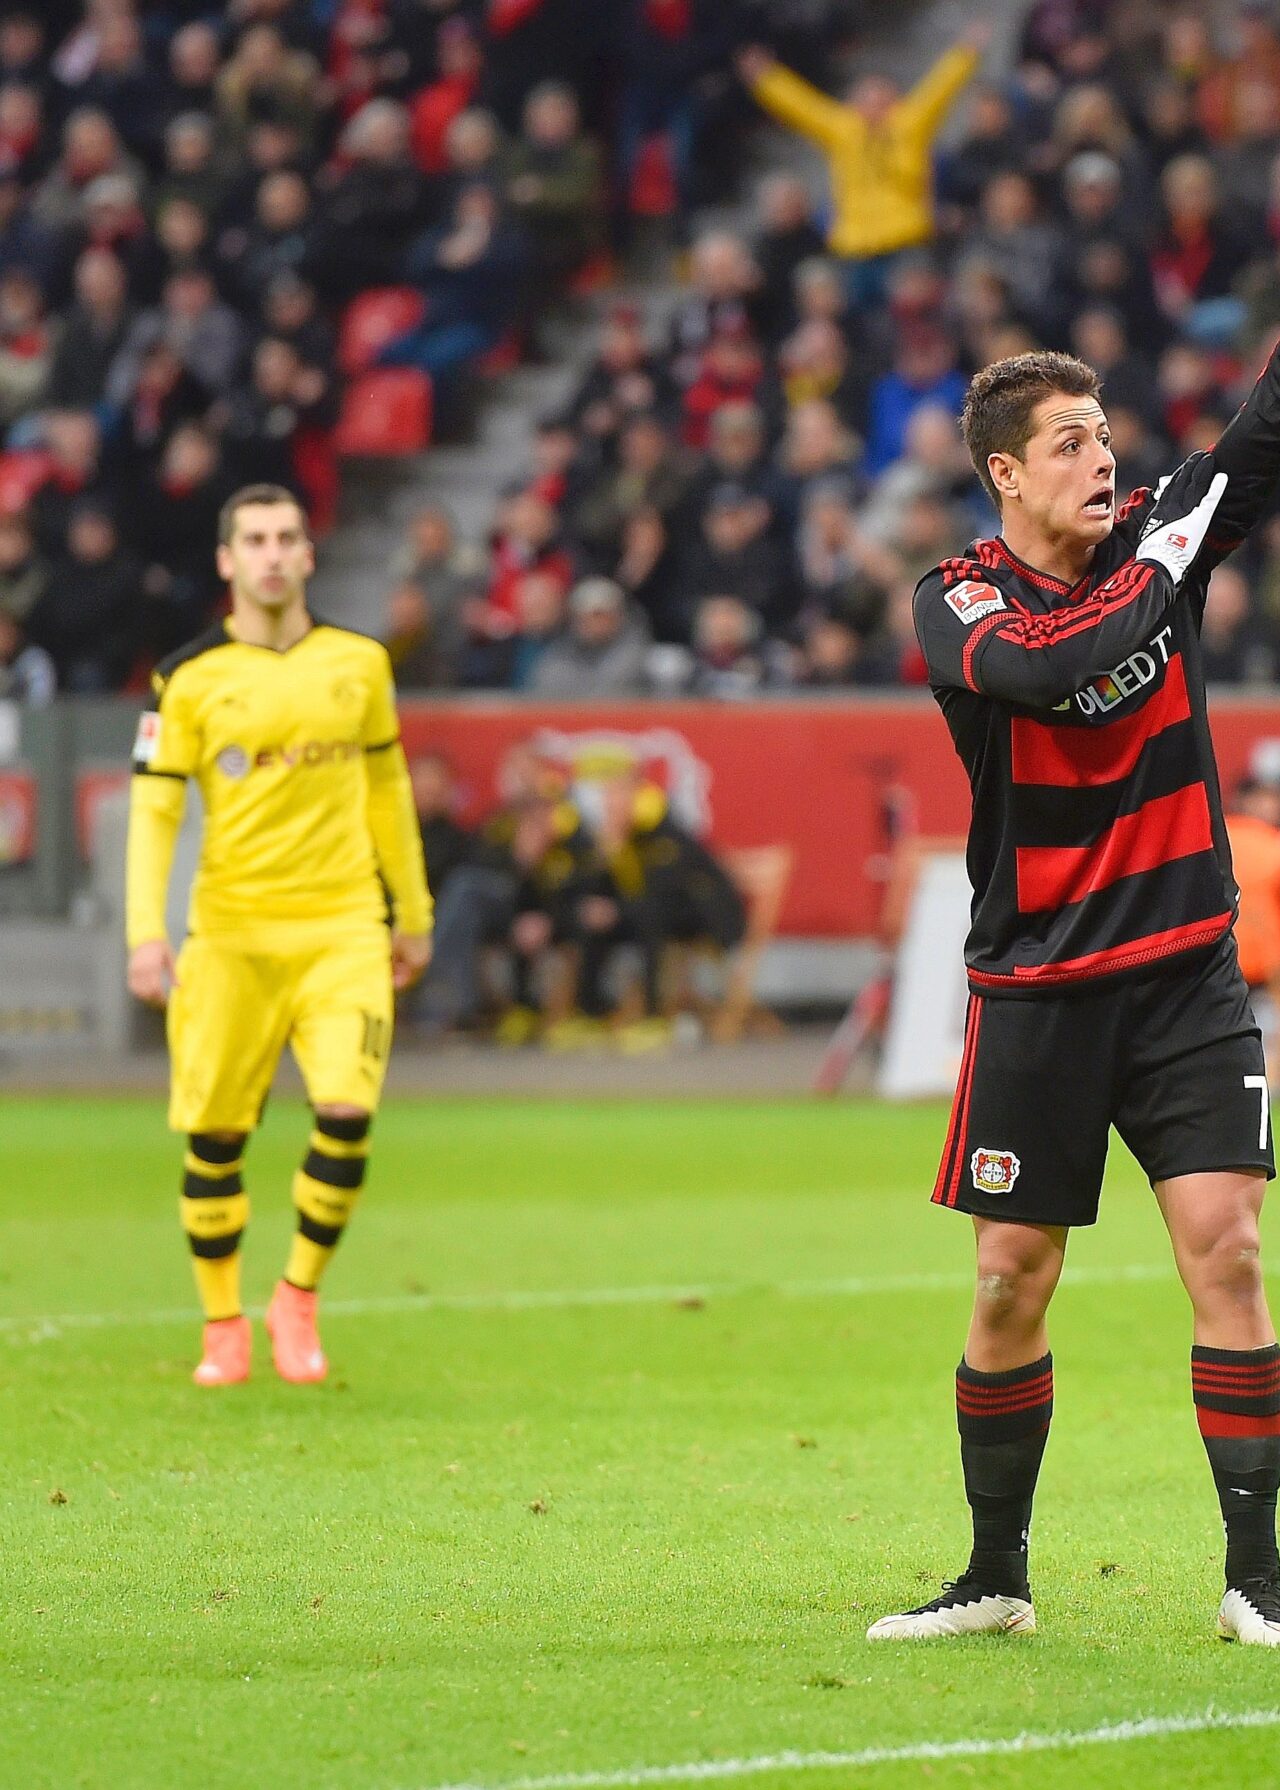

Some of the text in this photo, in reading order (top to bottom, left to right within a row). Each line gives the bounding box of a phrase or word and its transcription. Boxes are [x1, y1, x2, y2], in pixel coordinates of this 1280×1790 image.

[1075, 625, 1172, 713] OLED T
[1243, 1075, 1268, 1150] 7
